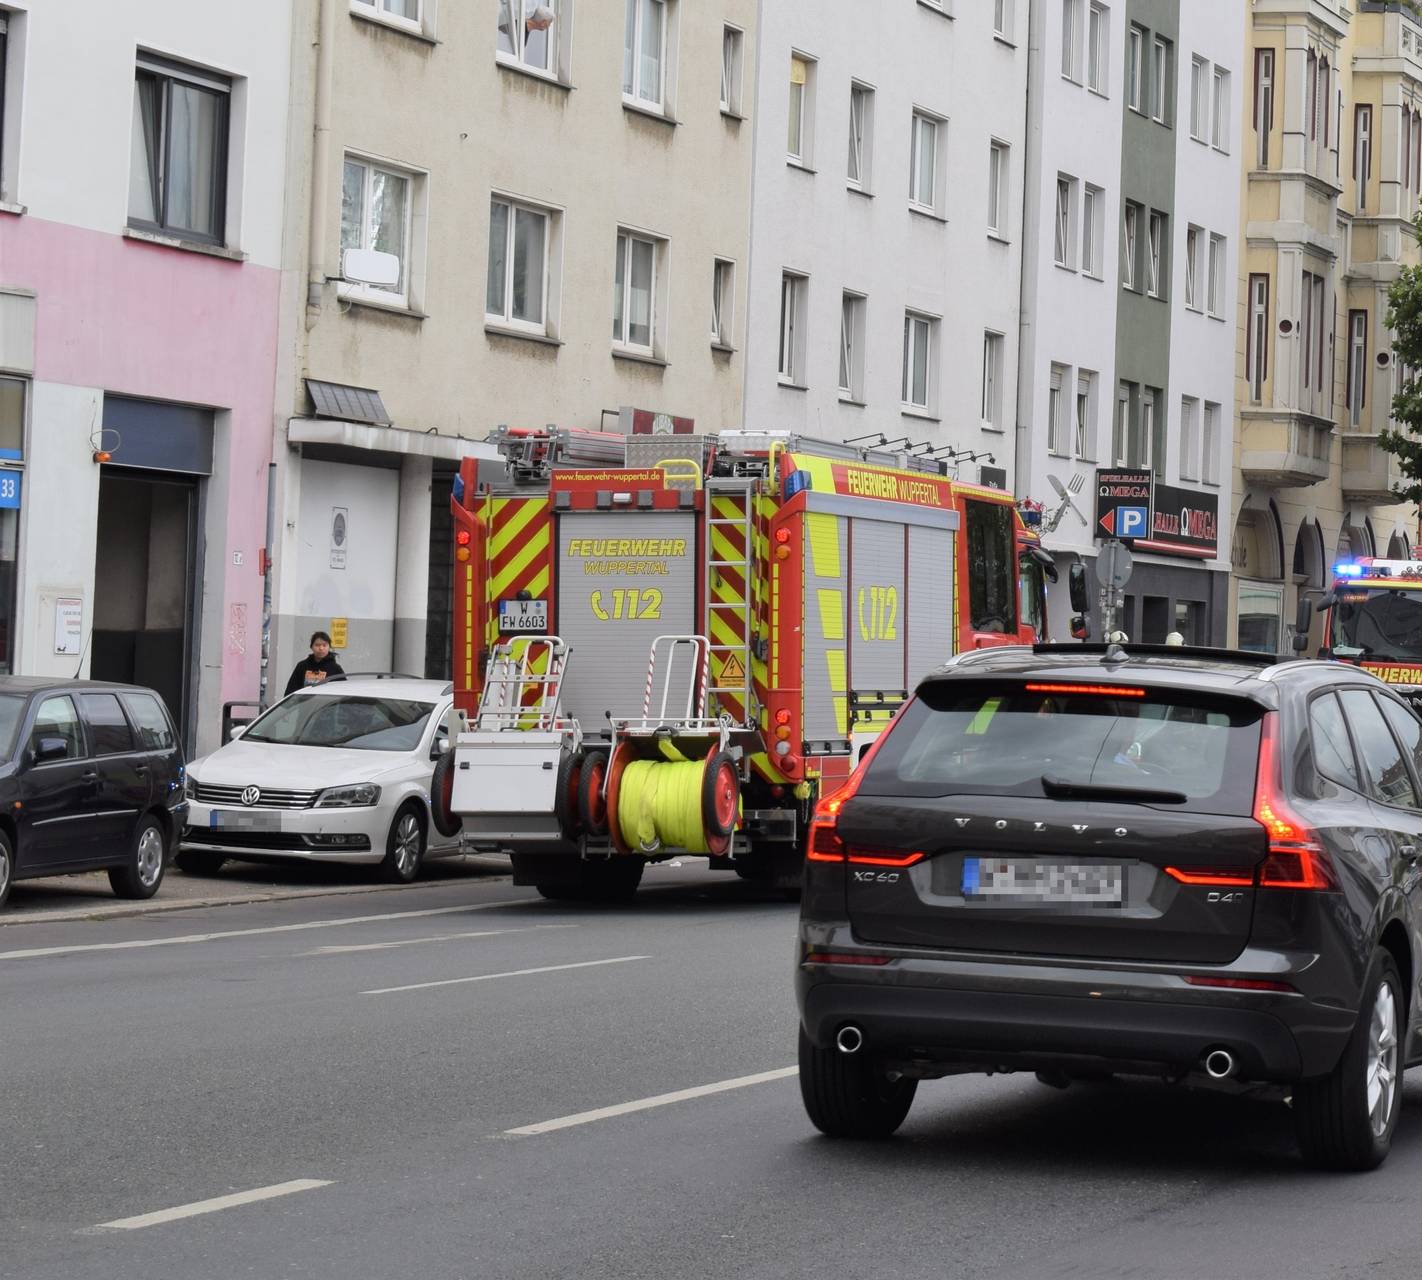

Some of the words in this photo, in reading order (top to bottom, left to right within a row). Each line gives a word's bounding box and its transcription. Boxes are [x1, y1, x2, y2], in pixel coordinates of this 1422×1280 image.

[555, 471, 660, 482] www.feuerwehr-wuppertal.de
[1, 479, 15, 498] 33
[848, 469, 899, 499] FEUERWEHR
[900, 480, 941, 506] WUPPERTAL
[1124, 510, 1142, 534] P
[1154, 511, 1179, 535] HALLE
[568, 539, 687, 557] FEUERWEHR
[584, 560, 670, 575] WUPPERTAL
[521, 602, 528, 615] W
[612, 588, 663, 620] 112
[870, 585, 897, 640] 112
[502, 616, 516, 628] FW
[519, 616, 545, 628] 6603
[954, 817, 1128, 837] VOLVO
